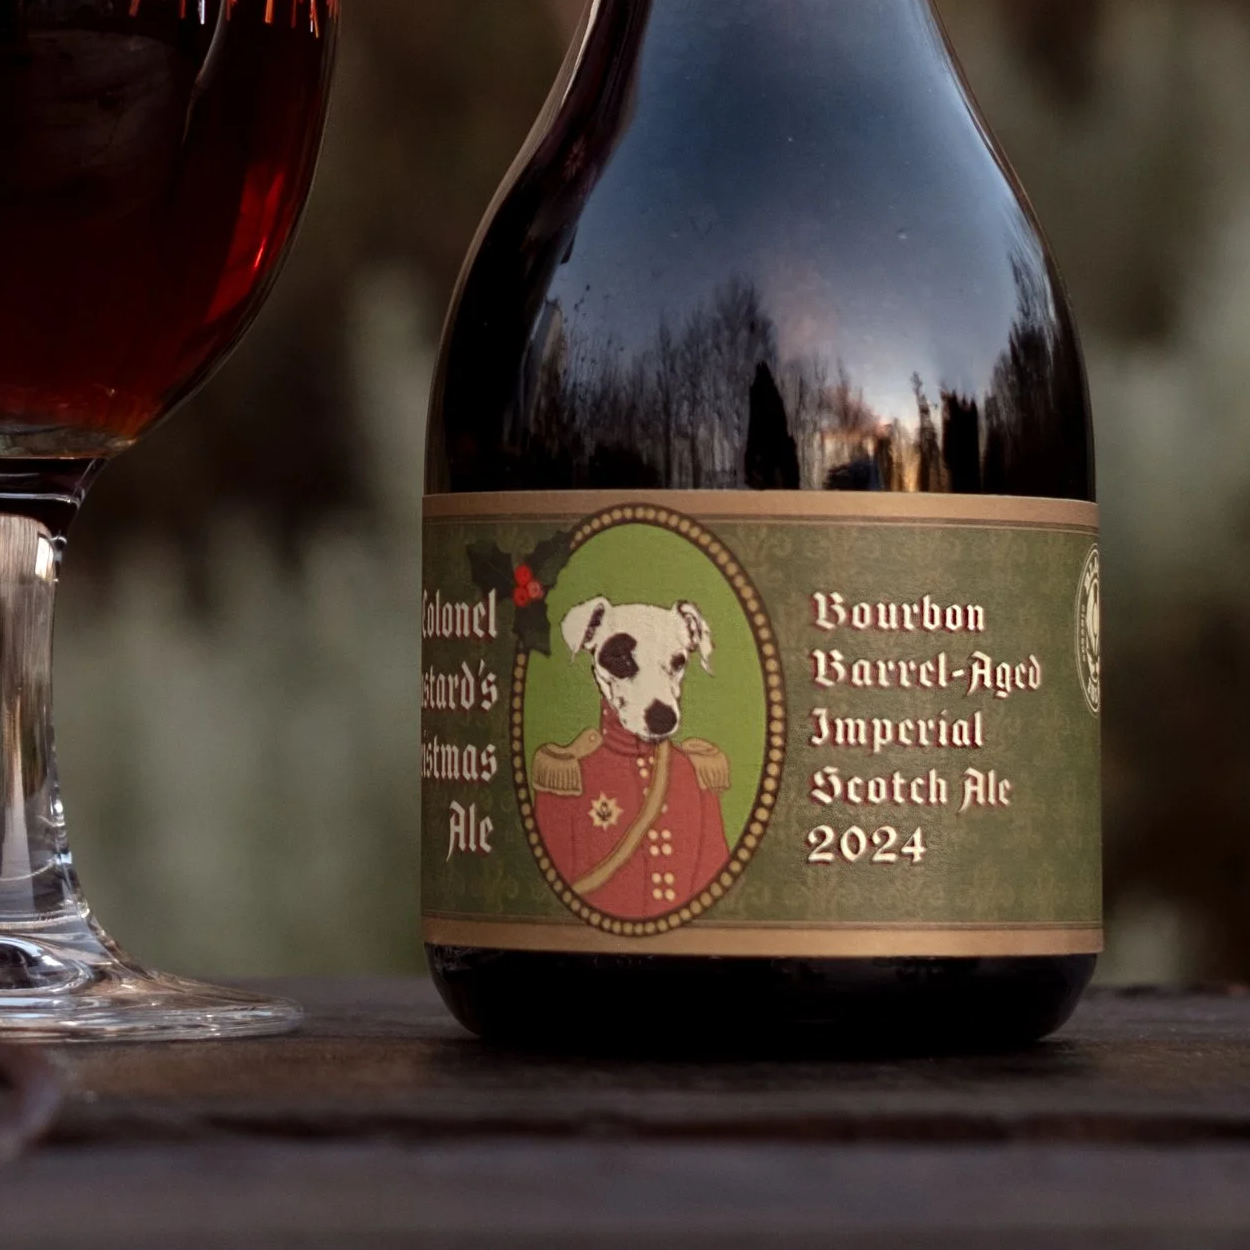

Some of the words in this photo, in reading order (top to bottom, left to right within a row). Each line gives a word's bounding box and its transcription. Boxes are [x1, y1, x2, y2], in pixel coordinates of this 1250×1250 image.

[812, 591, 986, 631] Bourbon
[811, 649, 1042, 698] Barrel-Aged
[810, 707, 984, 753] Imperial
[810, 766, 948, 804] Scotch
[958, 766, 1013, 814] Ale
[445, 800, 495, 862] Ale
[807, 824, 927, 863] 2024
